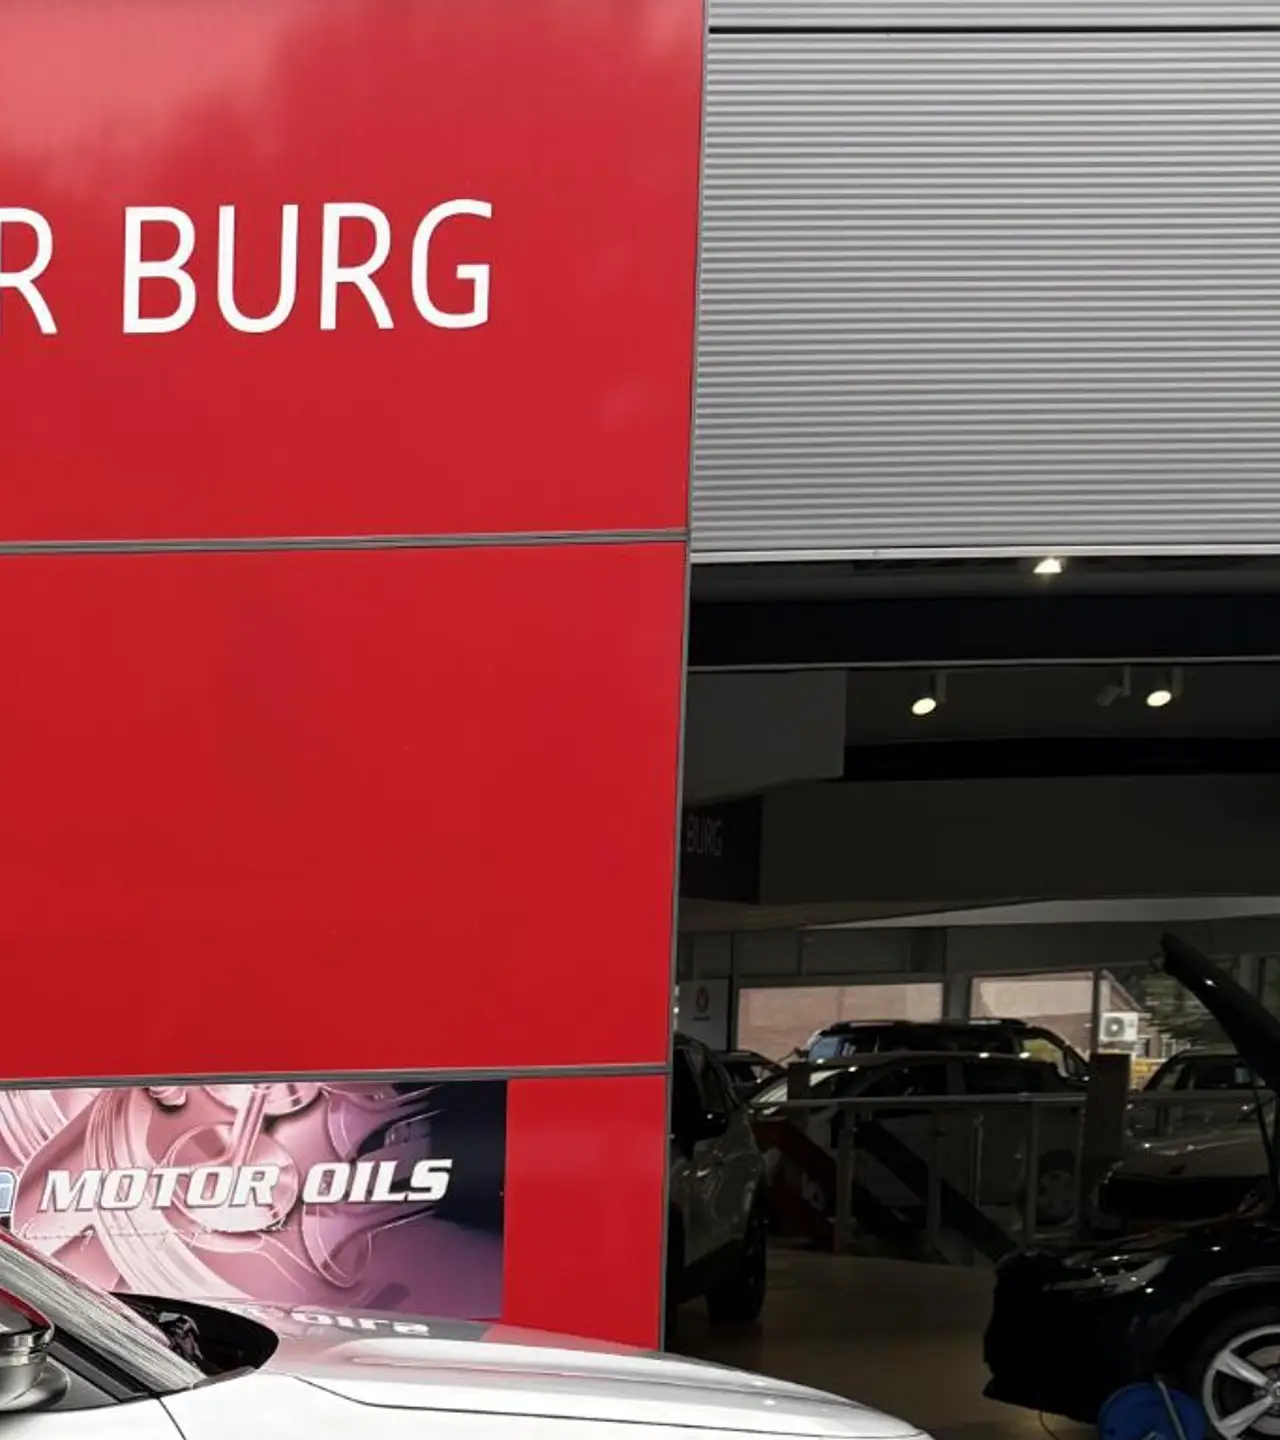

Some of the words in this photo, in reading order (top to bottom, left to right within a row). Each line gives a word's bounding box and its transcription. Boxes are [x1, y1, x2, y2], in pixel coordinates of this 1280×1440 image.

[122, 199, 493, 333] BURG
[38, 1167, 280, 1214] MOTOR
[302, 1158, 453, 1203] OILS
